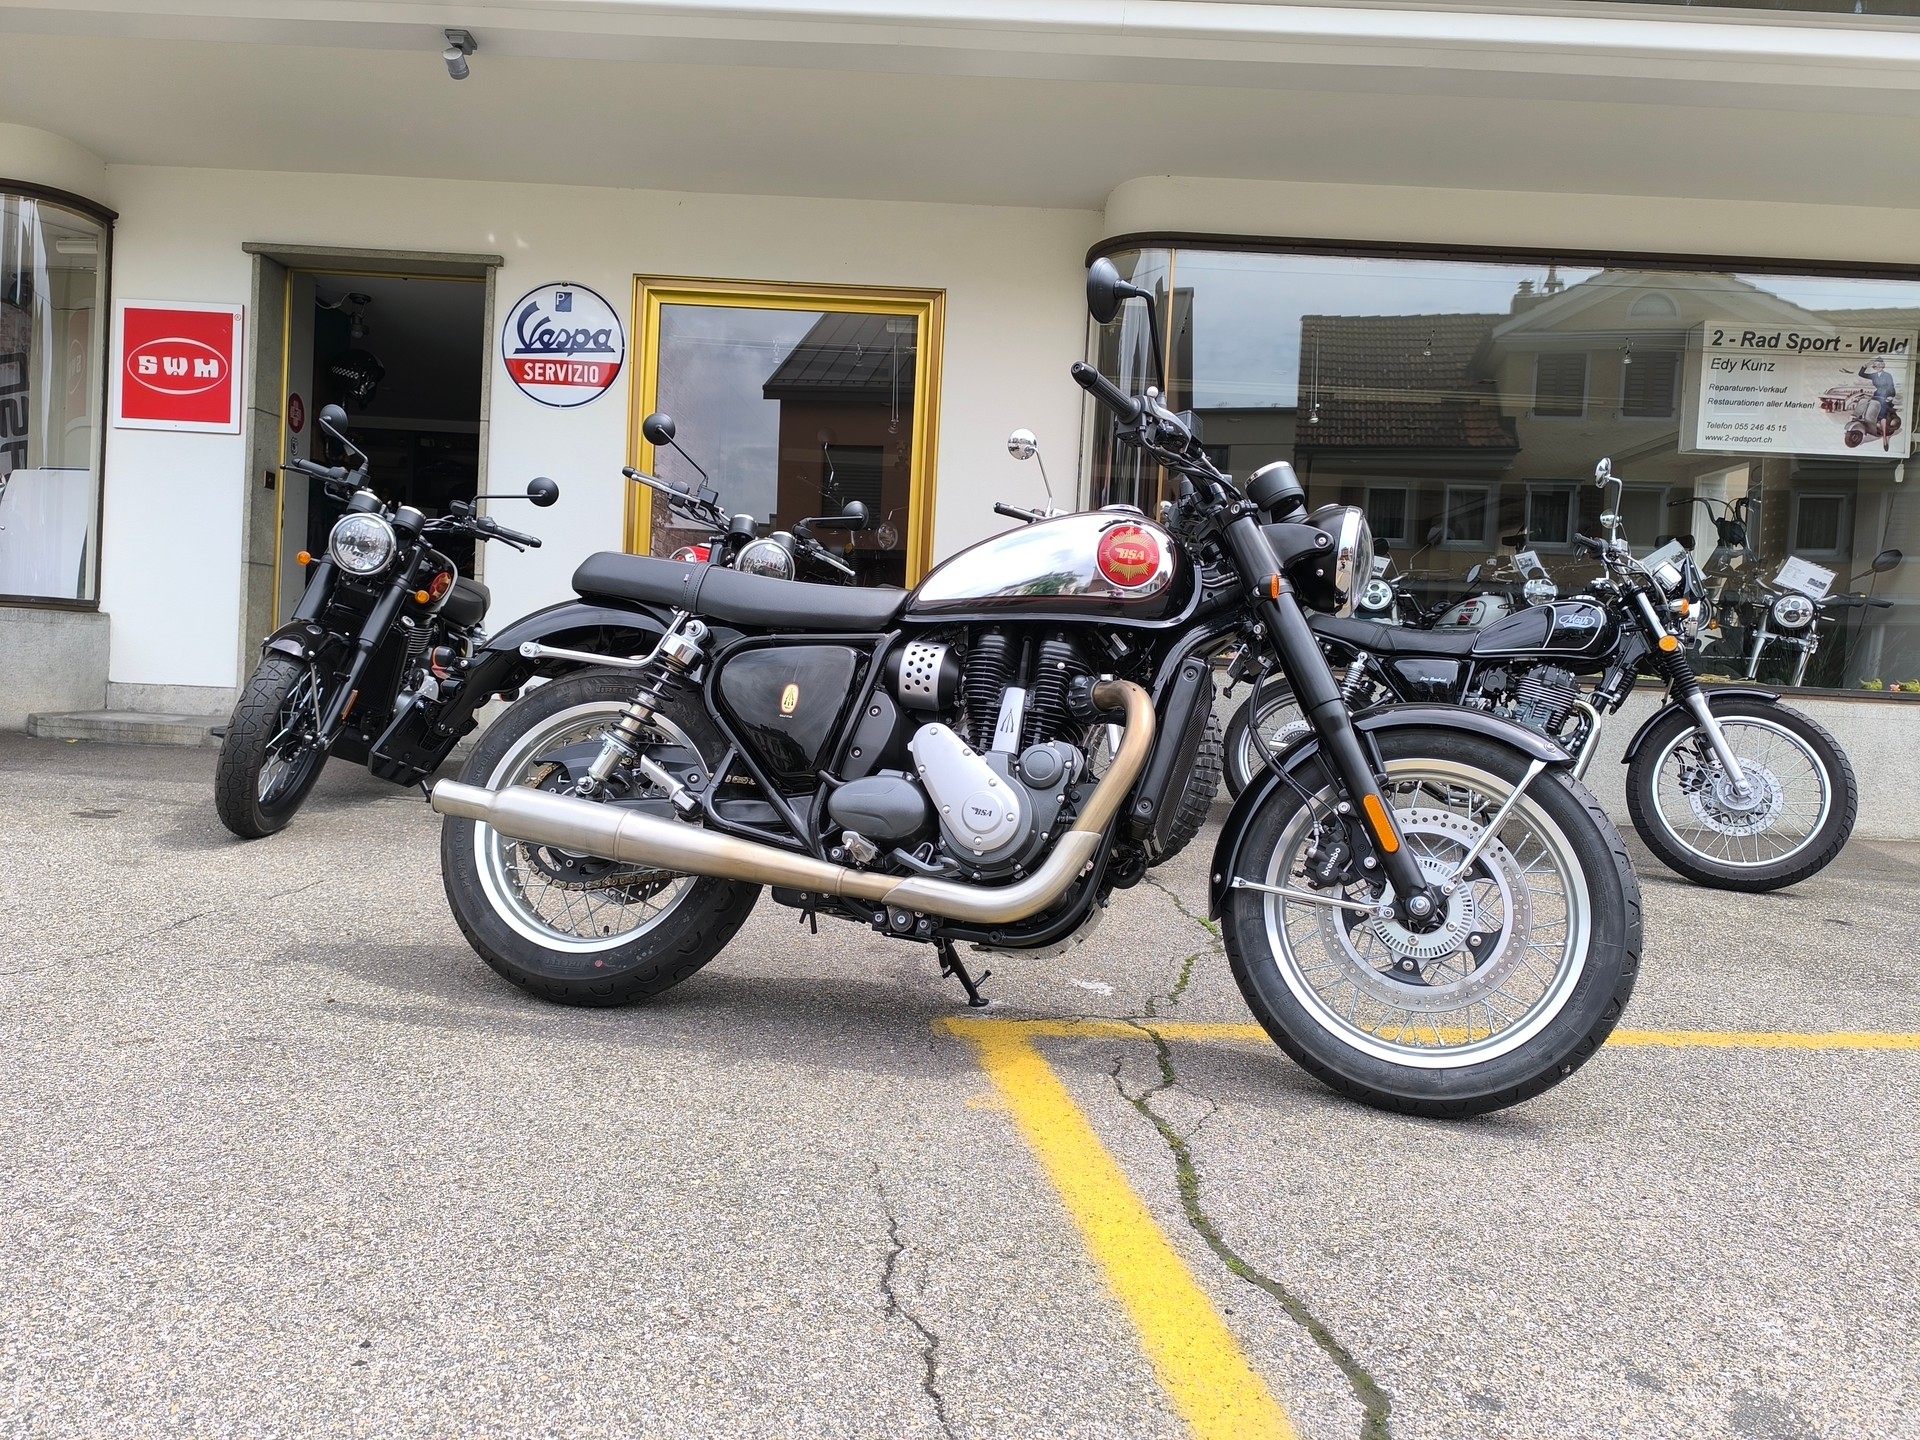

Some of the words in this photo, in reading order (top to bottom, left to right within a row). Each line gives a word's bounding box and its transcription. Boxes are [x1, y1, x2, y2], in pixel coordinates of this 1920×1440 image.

[513, 300, 616, 357] Vespa
[1711, 329, 1724, 346] 2
[1740, 330, 1780, 348] Rad
[1786, 332, 1841, 354] Sport
[1858, 336, 1909, 354] Wald
[137, 355, 220, 379] SWM
[523, 361, 599, 384] SERVIZIO
[1710, 357, 1737, 374] Edy
[1740, 358, 1775, 372] Kunz
[1708, 383, 1788, 394] Reparaturen-Verkauf
[1707, 397, 1765, 407] Restaurationen
[1784, 400, 1816, 409] Marken!
[1706, 421, 1733, 430] Telefon
[1734, 422, 1749, 431] 055
[1750, 423, 1765, 431] 246
[1766, 424, 1776, 432] 45
[1705, 434, 1773, 444] www.2-radsport.ch
[1115, 547, 1145, 560] BSA
[970, 806, 993, 817] BSA
[1321, 847, 1341, 877] brembo
